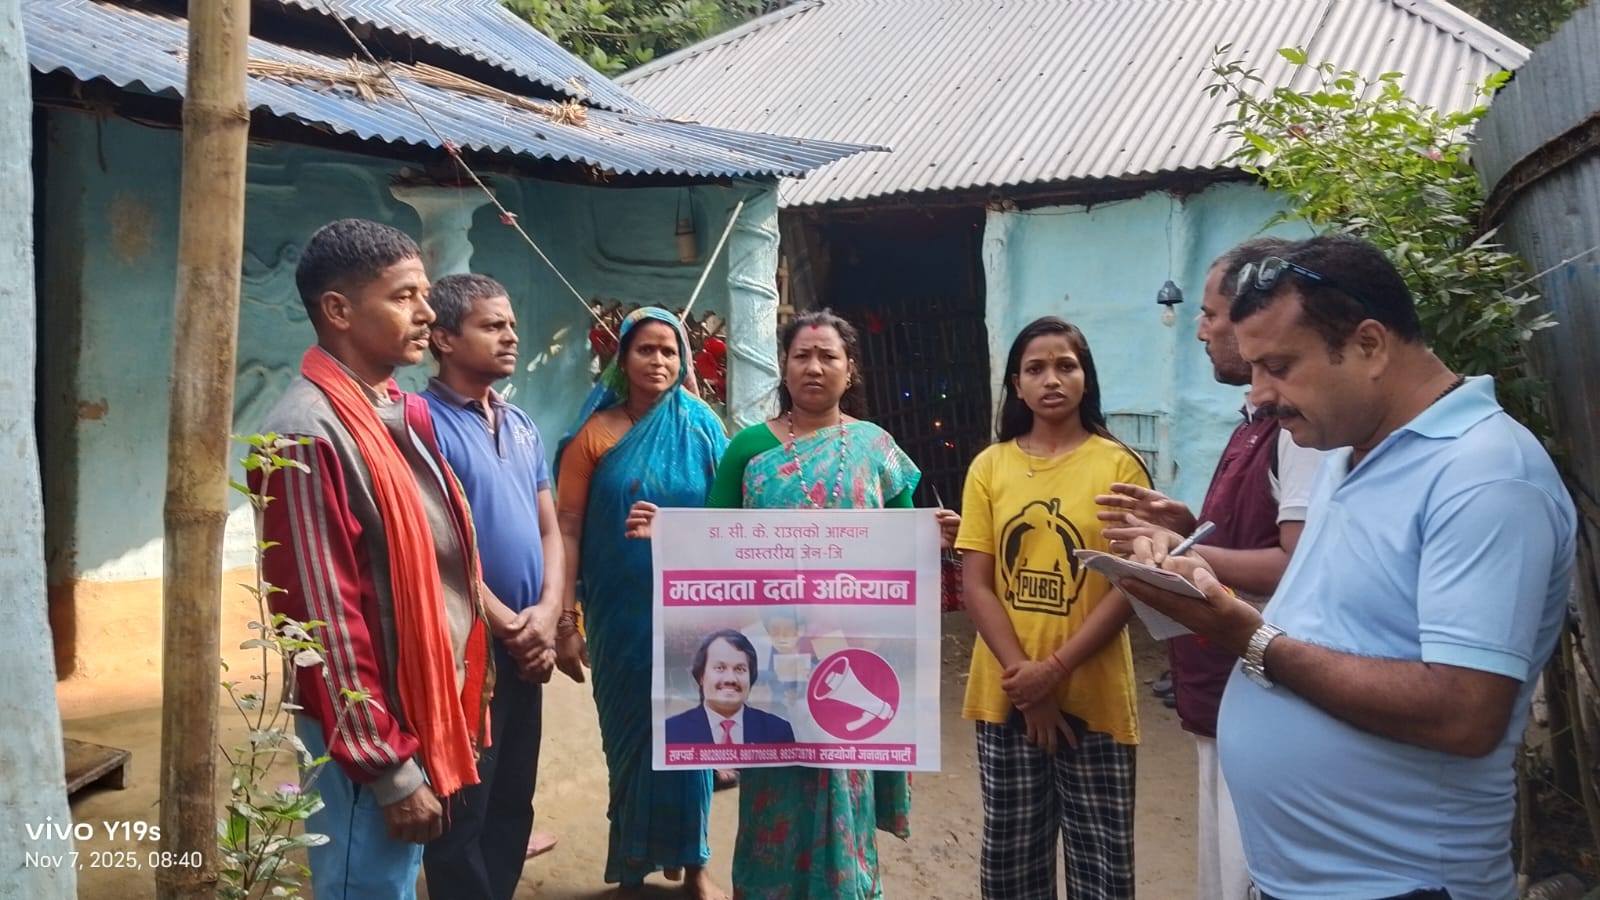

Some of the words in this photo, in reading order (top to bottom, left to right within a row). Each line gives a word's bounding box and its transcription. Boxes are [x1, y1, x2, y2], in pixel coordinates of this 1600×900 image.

[728, 522, 748, 539] सी.
[751, 523, 768, 539] के.
[774, 523, 820, 539] राउतको
[735, 544, 795, 560] वडास्तरीय
[799, 544, 843, 560] जेन-जि
[669, 579, 757, 601] मतदाता
[763, 574, 806, 601] दर्ता
[812, 573, 910, 600] अभियान
[1022, 576, 1058, 601] PUBG
[820, 746, 857, 760] सहयोगी
[891, 746, 912, 761] पार्टी
